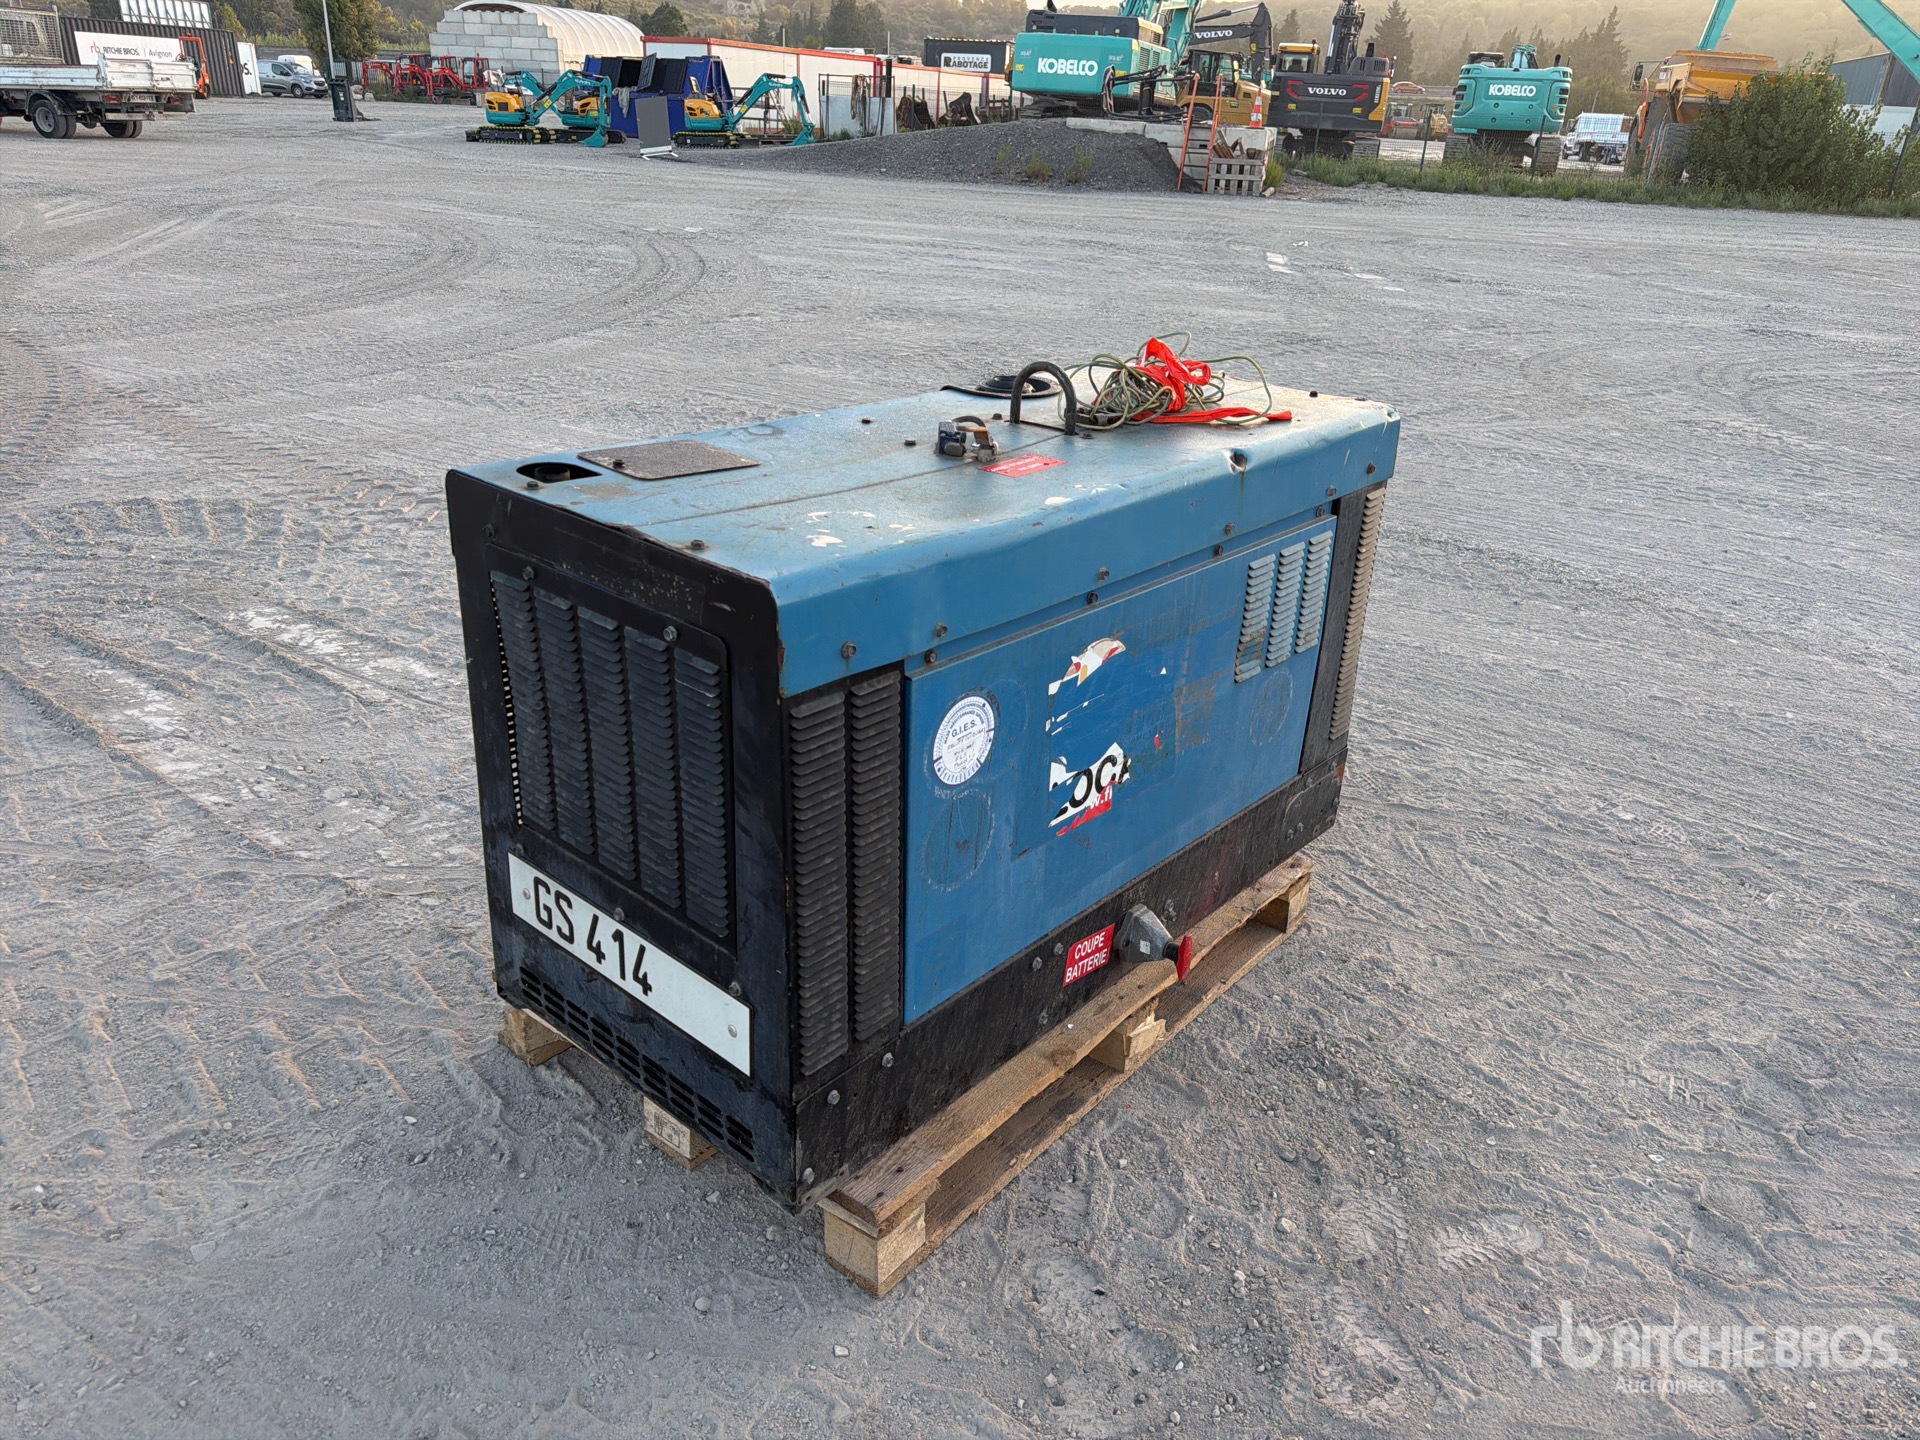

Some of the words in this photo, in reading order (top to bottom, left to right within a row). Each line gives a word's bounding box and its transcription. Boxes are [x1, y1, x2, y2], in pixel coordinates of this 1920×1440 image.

[1195, 30, 1233, 39] VOLVO
[103, 46, 122, 55] RITCHIE
[148, 49, 173, 58] Avignon
[943, 56, 989, 69] RABOTAGE
[1037, 57, 1098, 76] KOBELCO
[1307, 86, 1347, 96] VOLVO
[1488, 84, 1537, 97] KOBELCO
[951, 719, 978, 738] G.I.E.S.
[533, 876, 575, 945] GS
[586, 914, 653, 997] 414
[1074, 931, 1106, 960] COUPE
[1065, 948, 1108, 983] BATTERIE
